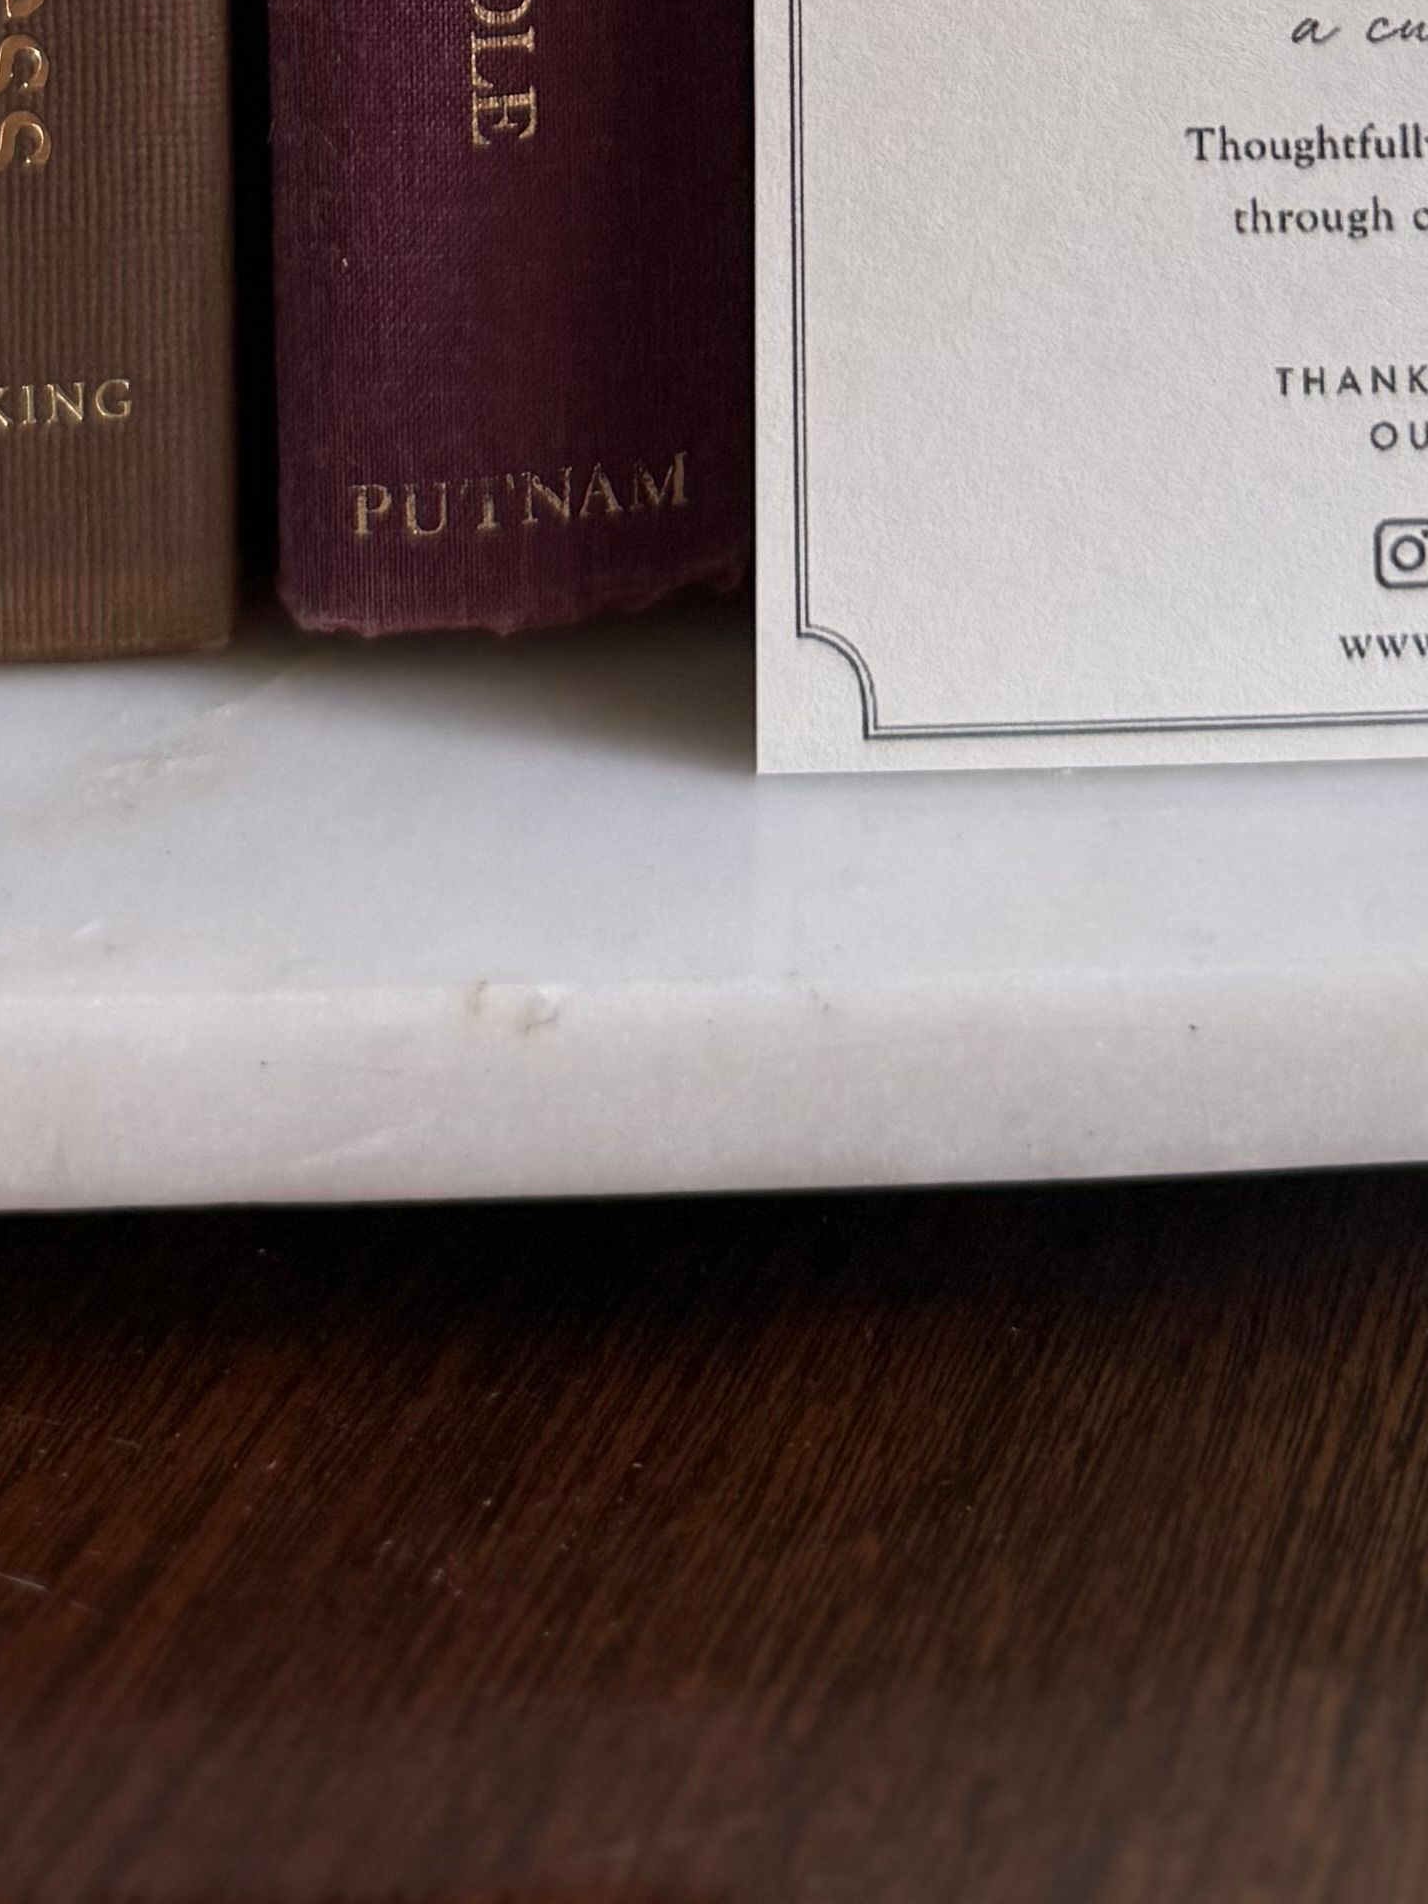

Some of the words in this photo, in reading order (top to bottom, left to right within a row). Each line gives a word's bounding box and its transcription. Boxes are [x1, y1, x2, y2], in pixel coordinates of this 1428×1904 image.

[1290, 12, 1340, 48] a
[1233, 194, 1396, 241] through
[349, 452, 692, 541] PUTNAM
